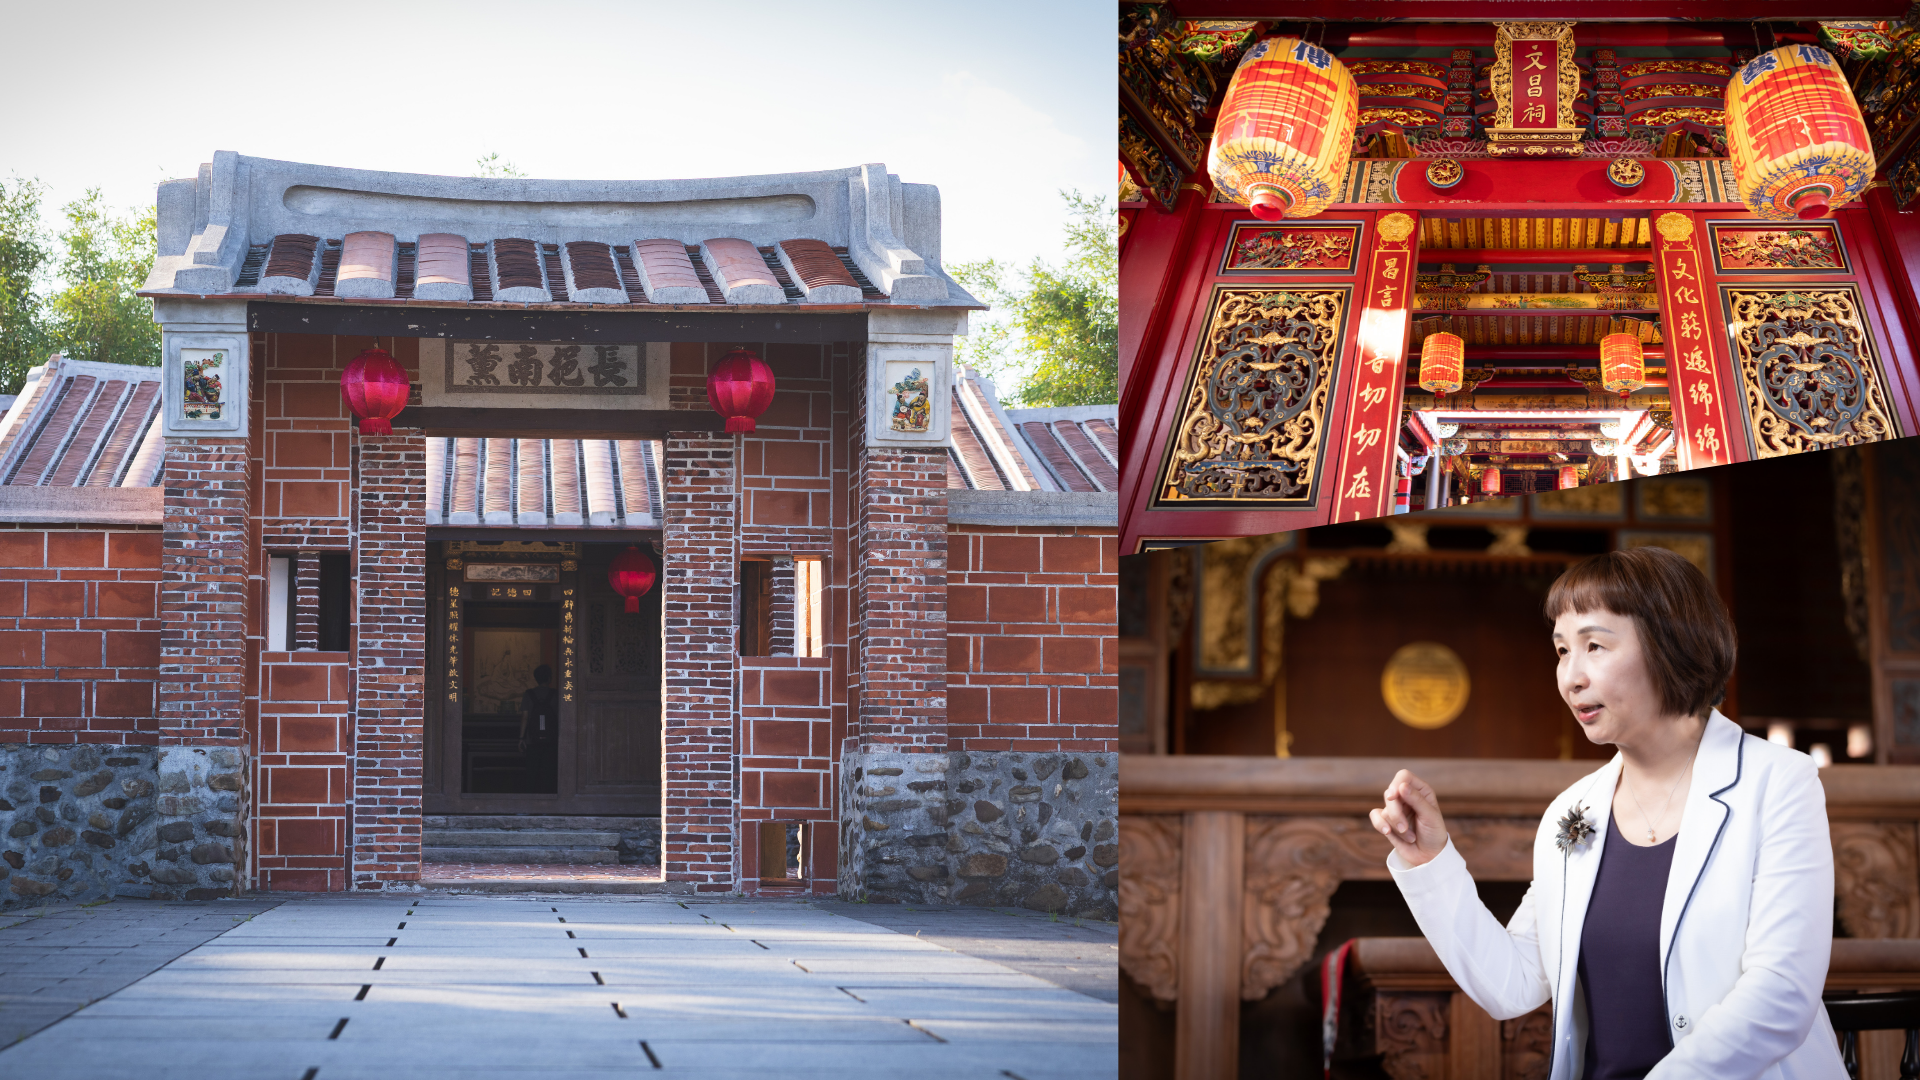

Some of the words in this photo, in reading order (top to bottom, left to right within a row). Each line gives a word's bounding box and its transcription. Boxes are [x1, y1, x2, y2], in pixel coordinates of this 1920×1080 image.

[1521, 44, 1547, 124] 文昌祠
[1345, 257, 1399, 521] 昌言音切切在
